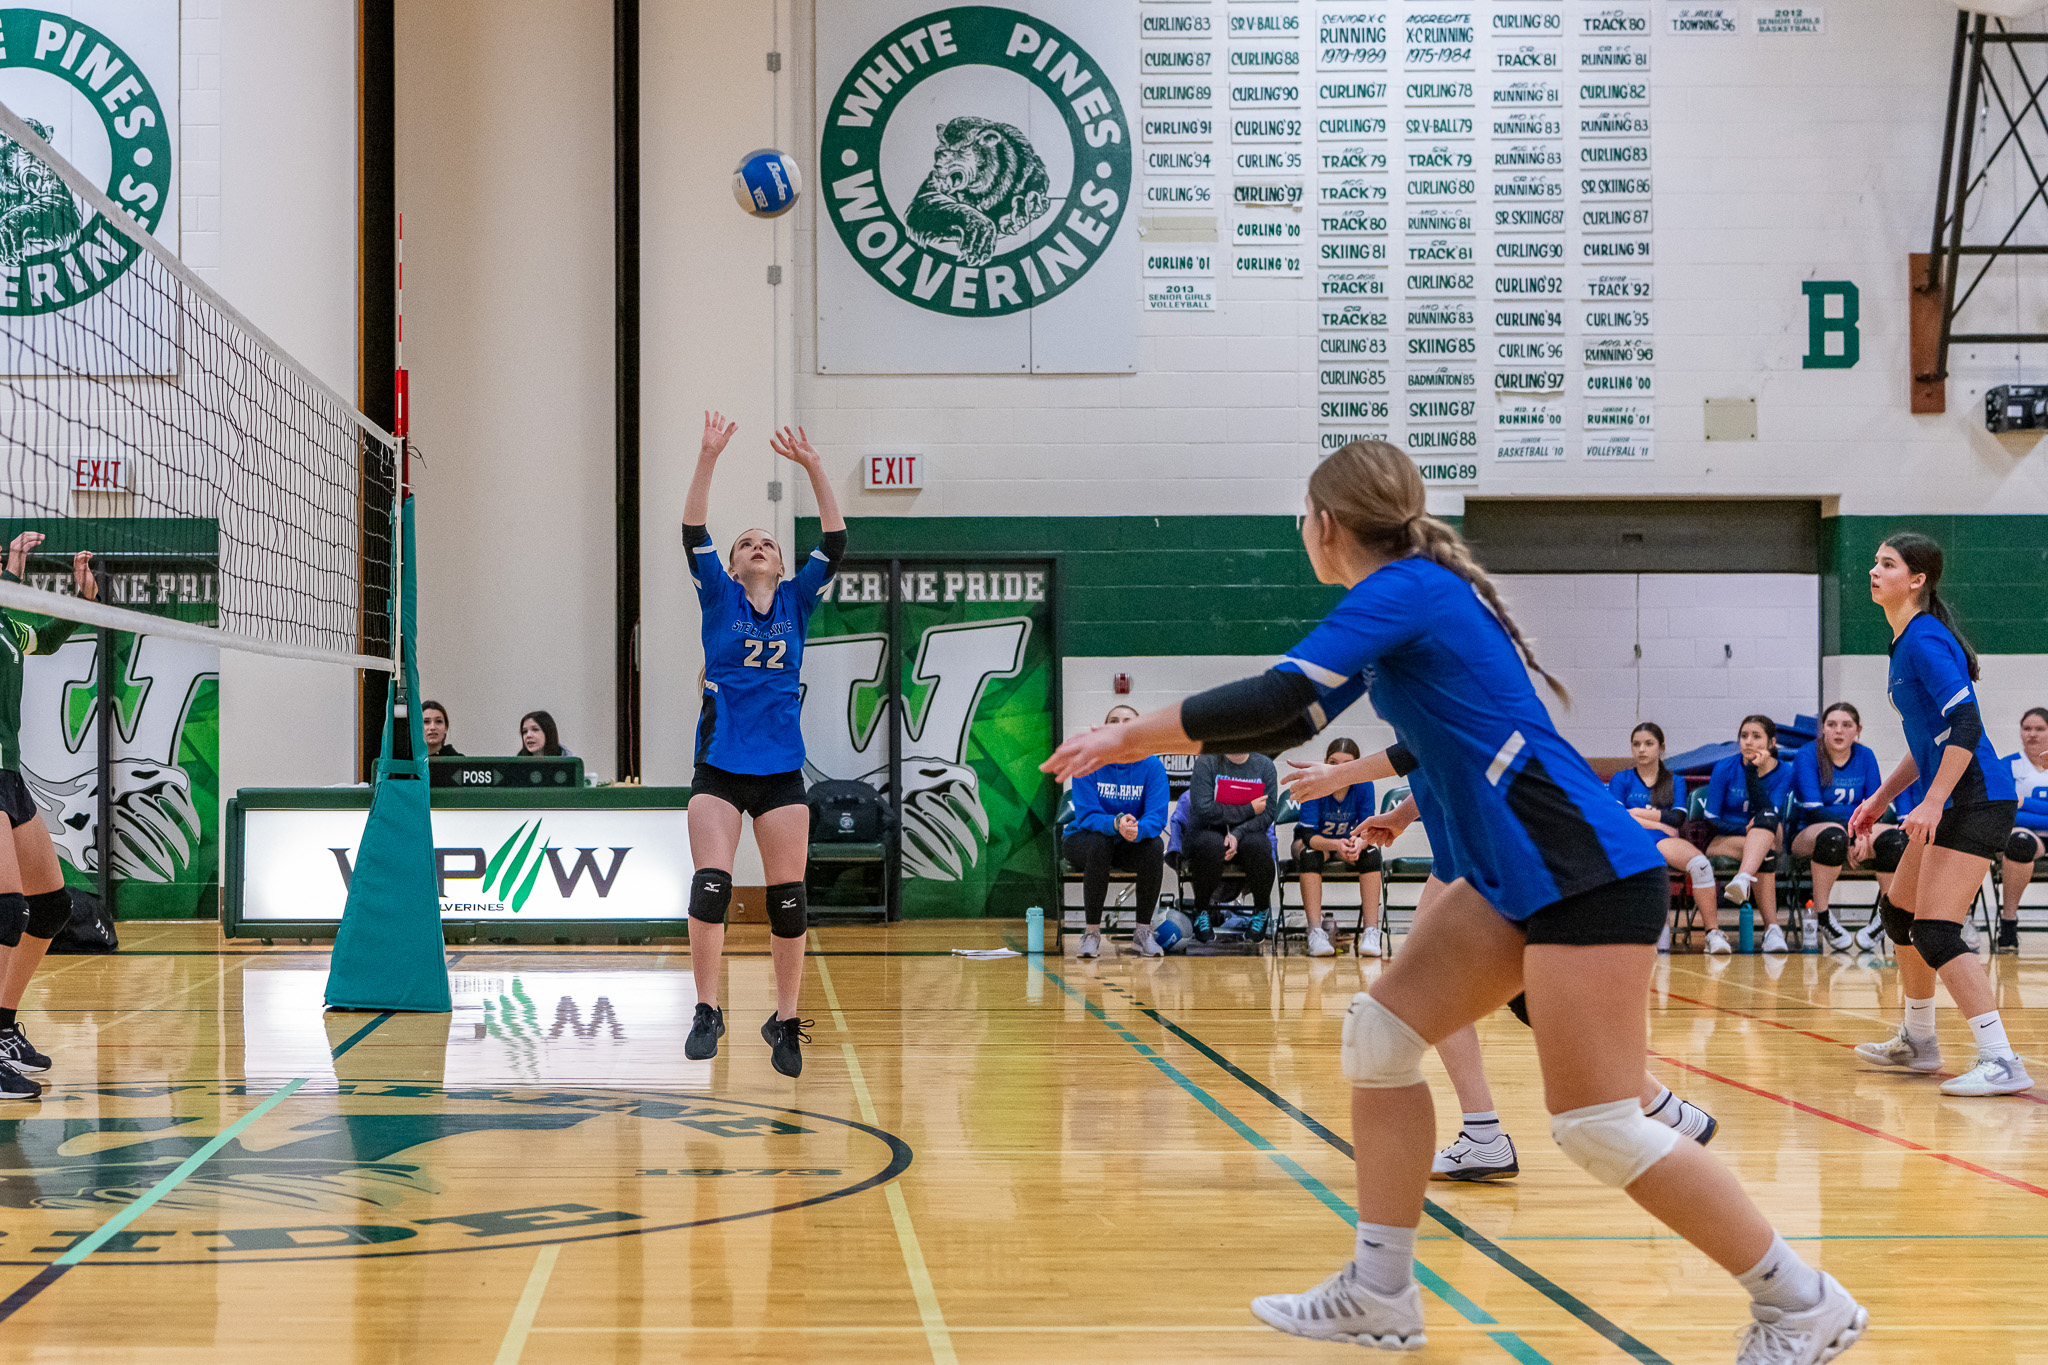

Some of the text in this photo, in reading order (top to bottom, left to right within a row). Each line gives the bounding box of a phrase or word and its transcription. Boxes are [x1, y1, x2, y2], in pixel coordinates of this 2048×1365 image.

[1322, 14, 1365, 24] SENIOR
[1320, 28, 1386, 43] RUNNING
[1424, 28, 1473, 43] RUNNING
[1322, 49, 1386, 63] 1979-1989
[1406, 49, 1471, 63] 1975-1984
[1581, 54, 1631, 65] RUNNING
[34, 19, 156, 139] PINES
[837, 21, 1121, 148] WHITE PINES
[1237, 224, 1282, 236] CURLING
[832, 169, 1119, 309] WOLVERINES
[1148, 257, 1193, 269] CURLING
[1237, 257, 1282, 270] CURLING
[1802, 281, 1860, 369] B
[1587, 377, 1632, 390] CURLING
[1499, 415, 1544, 424] RUNNING
[1588, 415, 1633, 424] RUNNING
[1498, 448, 1548, 457] BASKETBALL
[1587, 447, 1635, 456] VOLLEYBALL
[76, 459, 121, 488] EXIT
[872, 457, 916, 485] EXIT
[943, 571, 1045, 602] PRIDE
[744, 639, 786, 669] 22
[463, 770, 492, 784] POSS
[1834, 788, 1854, 804] 21
[635, 1168, 844, 1177] 1973
